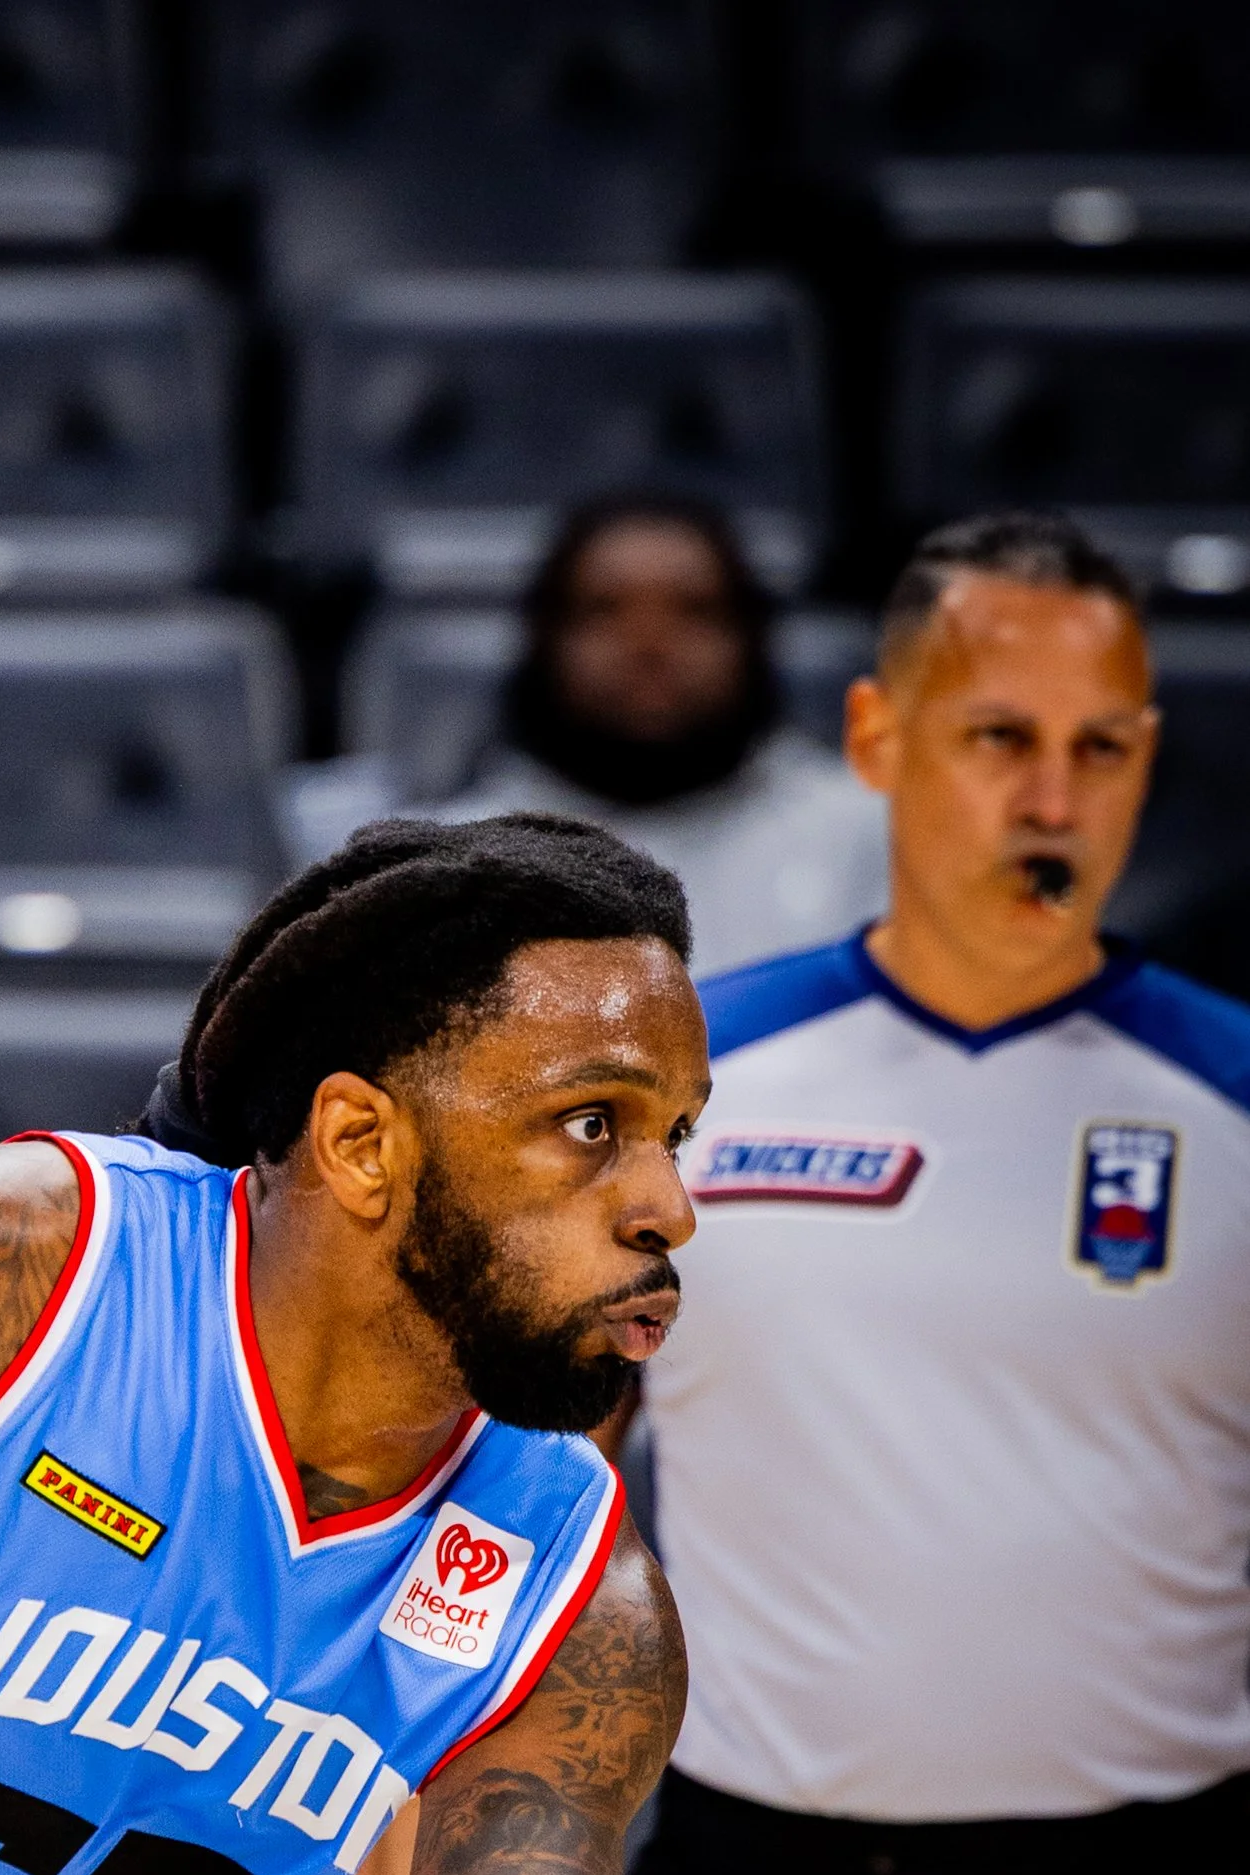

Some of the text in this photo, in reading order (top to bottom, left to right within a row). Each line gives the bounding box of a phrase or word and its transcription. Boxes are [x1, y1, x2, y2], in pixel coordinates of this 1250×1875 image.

[38, 1466, 149, 1544] PANINI
[393, 1601, 478, 1653] Radio
[406, 1577, 489, 1630] iHeart
